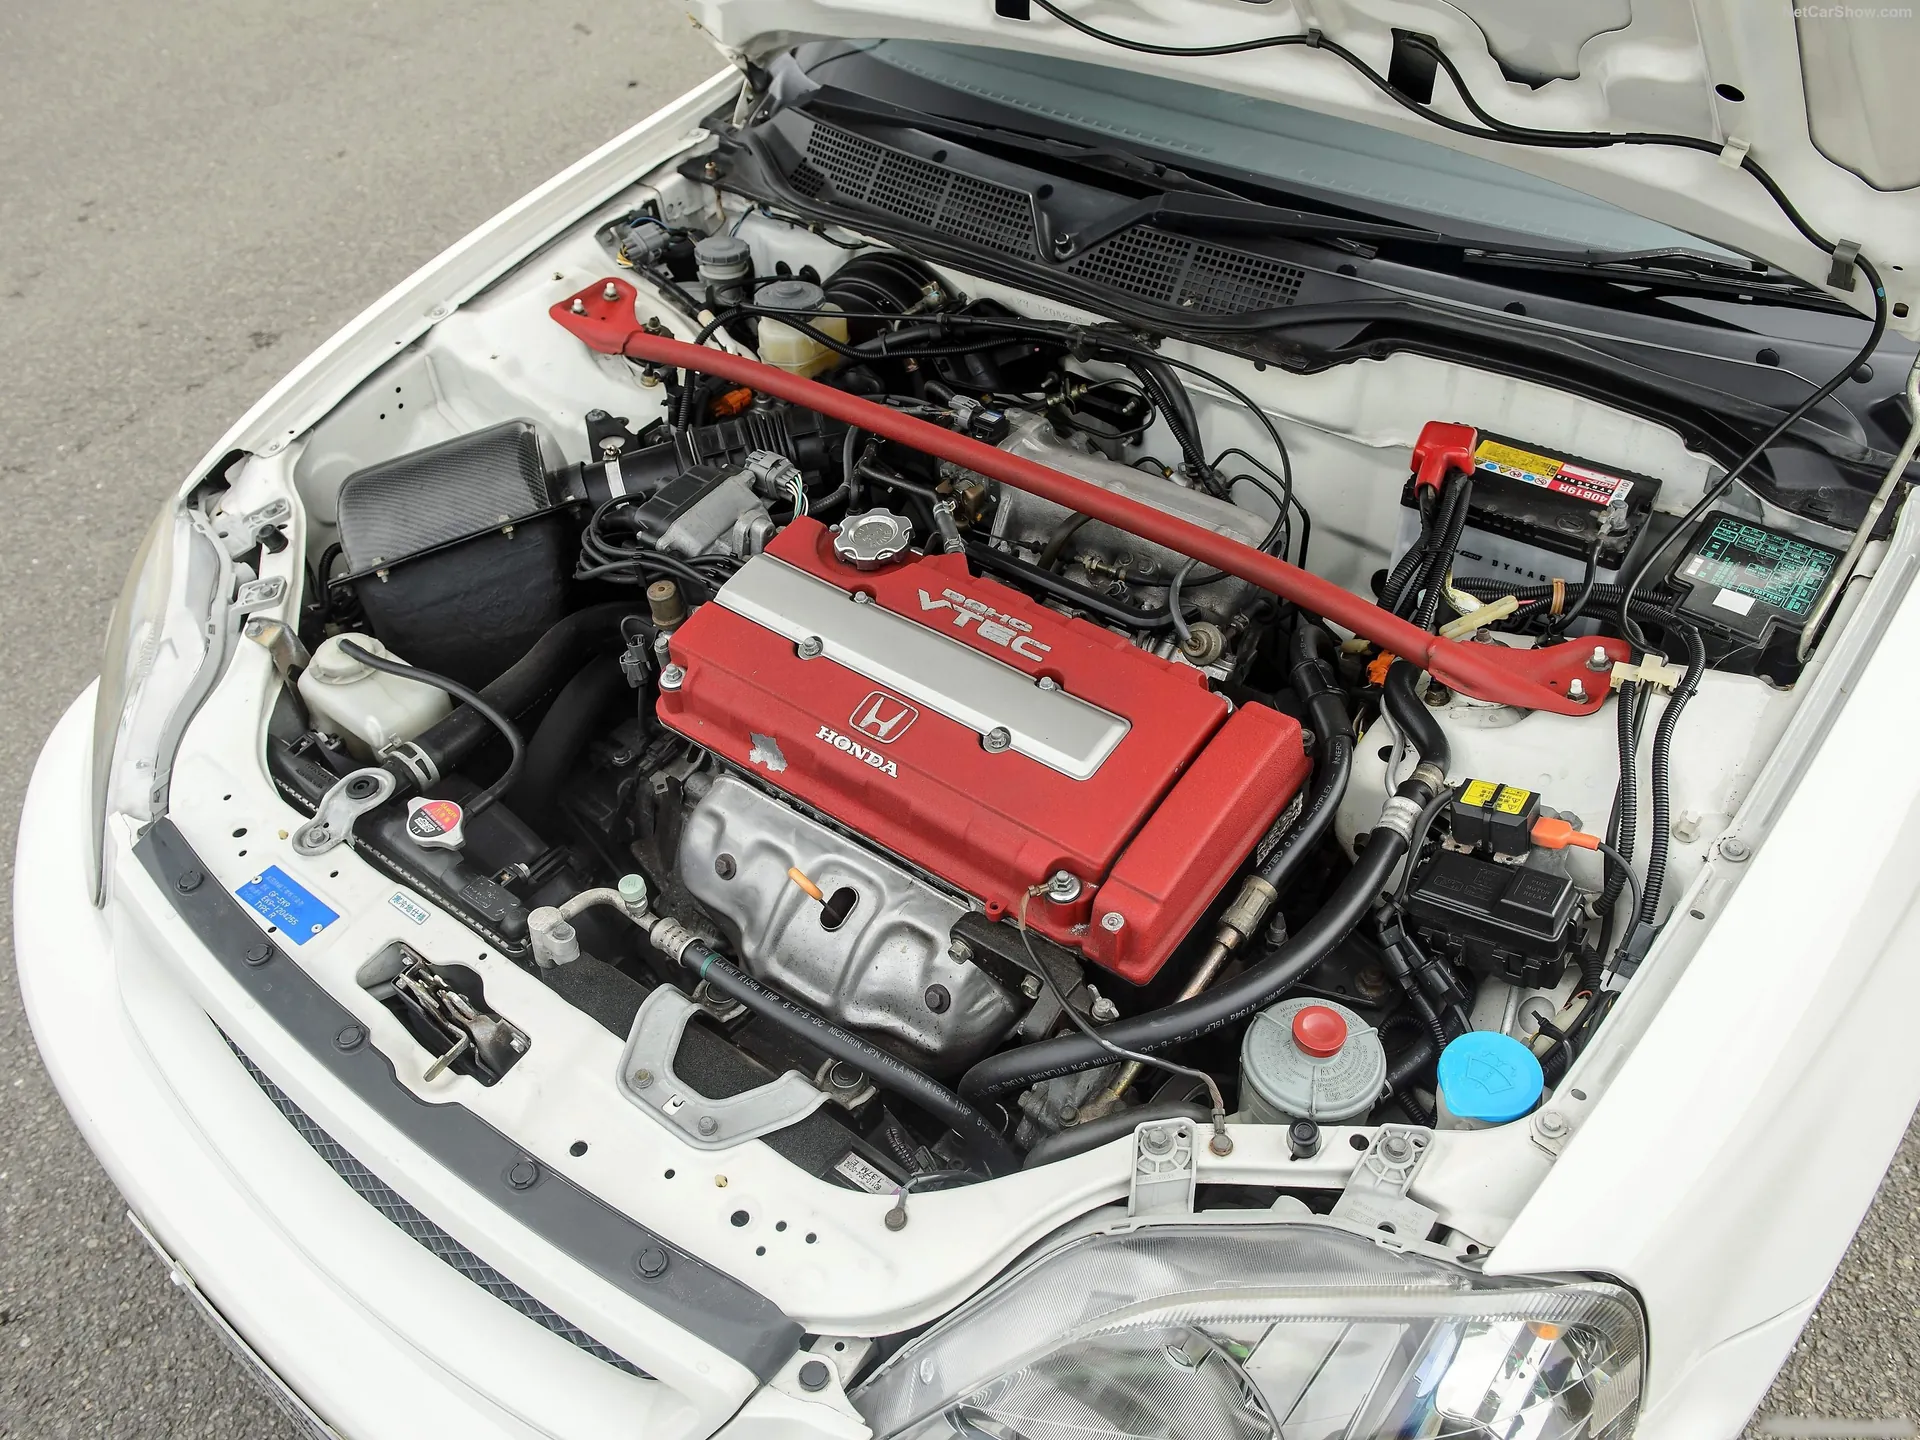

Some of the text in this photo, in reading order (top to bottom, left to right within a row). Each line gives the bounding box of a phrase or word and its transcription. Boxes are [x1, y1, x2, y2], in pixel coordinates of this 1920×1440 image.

[1559, 482, 1609, 503] 40B19R
[1492, 559, 1547, 582] DYNAG
[1754, 588, 1782, 602] BATTERY
[917, 588, 1052, 663] VTEC
[815, 725, 900, 779] HONDA
[254, 900, 270, 913] TYPE
[268, 890, 291, 908] GF-EK9
[261, 895, 299, 926] EK9-1204255
[737, 974, 761, 991] R134a
[828, 1026, 863, 1049] NICHIRIN
[863, 1047, 882, 1060] JPN
[882, 1055, 925, 1084] HYLAMMIT
[924, 1080, 951, 1102] R134a
[1070, 1060, 1090, 1070] JPN
